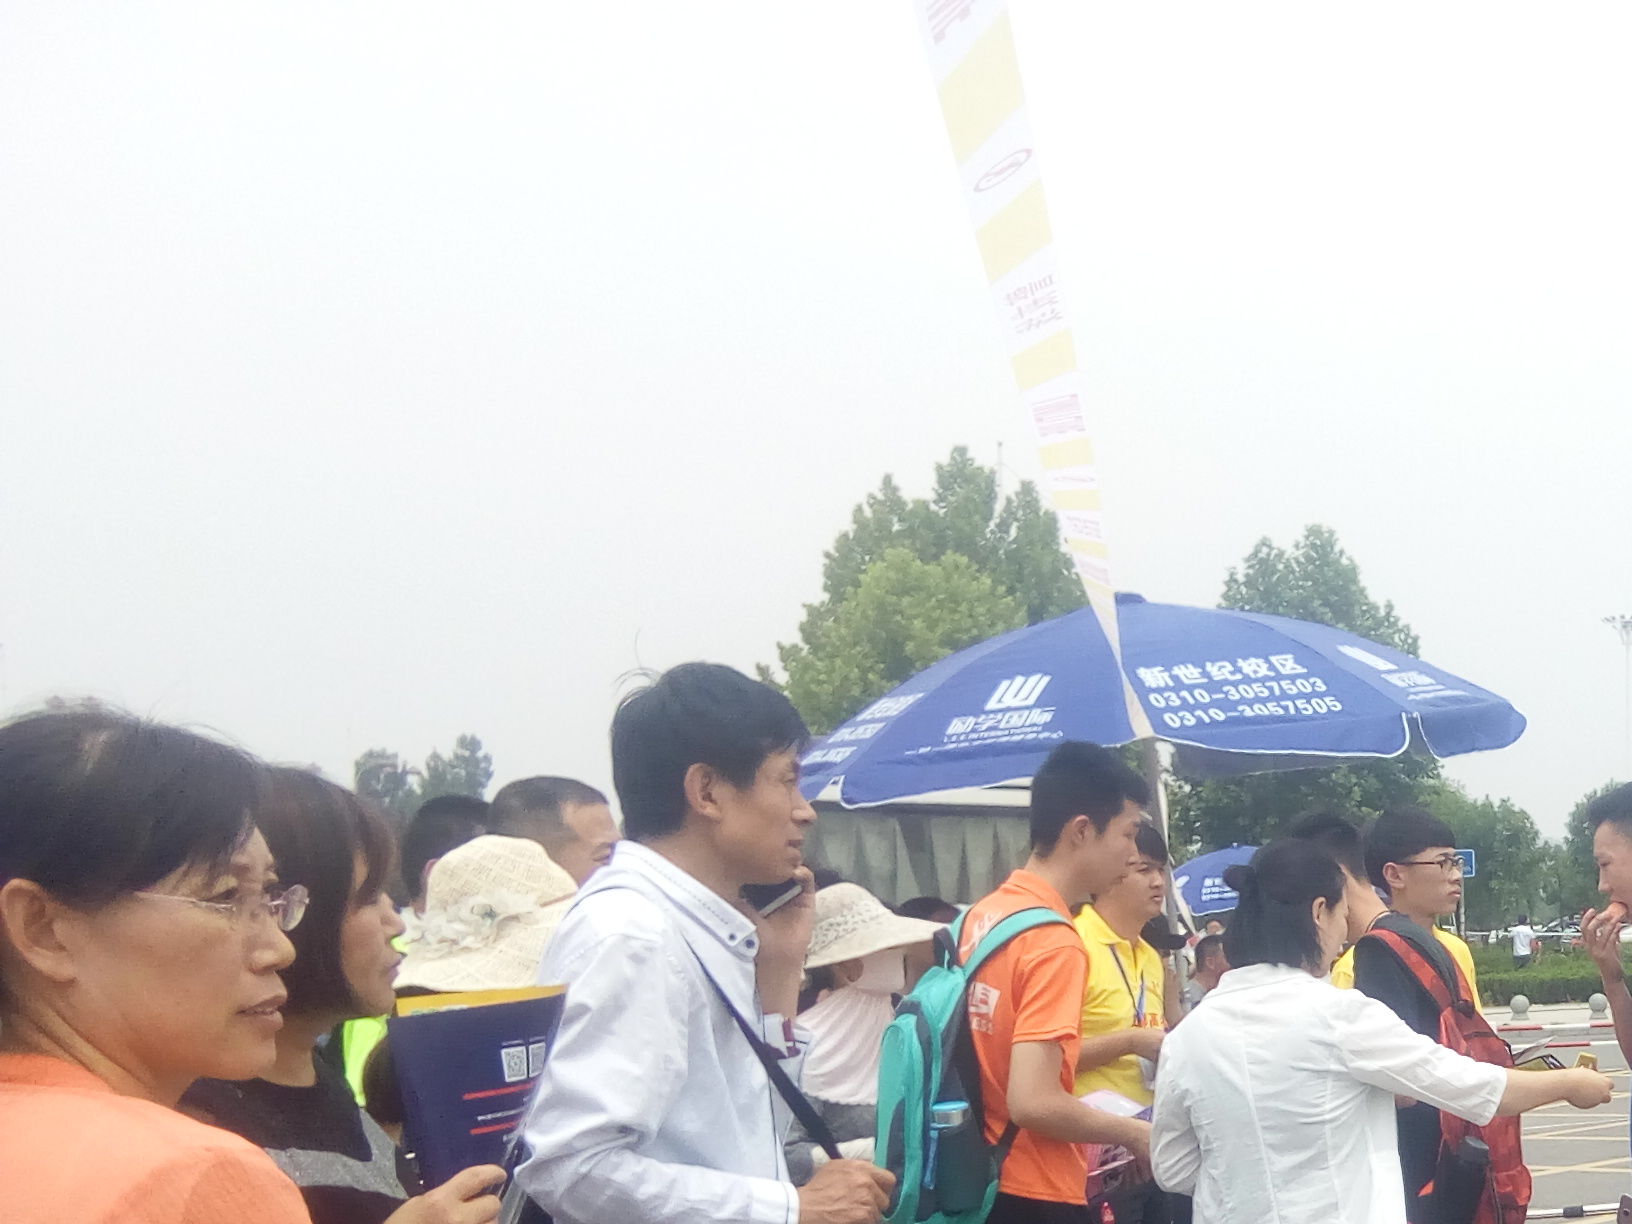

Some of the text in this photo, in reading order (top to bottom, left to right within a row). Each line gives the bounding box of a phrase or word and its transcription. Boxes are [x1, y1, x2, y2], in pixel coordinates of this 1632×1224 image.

[1136, 654, 1308, 688] 新世纪校区
[1147, 677, 1327, 708] 0310-3057503
